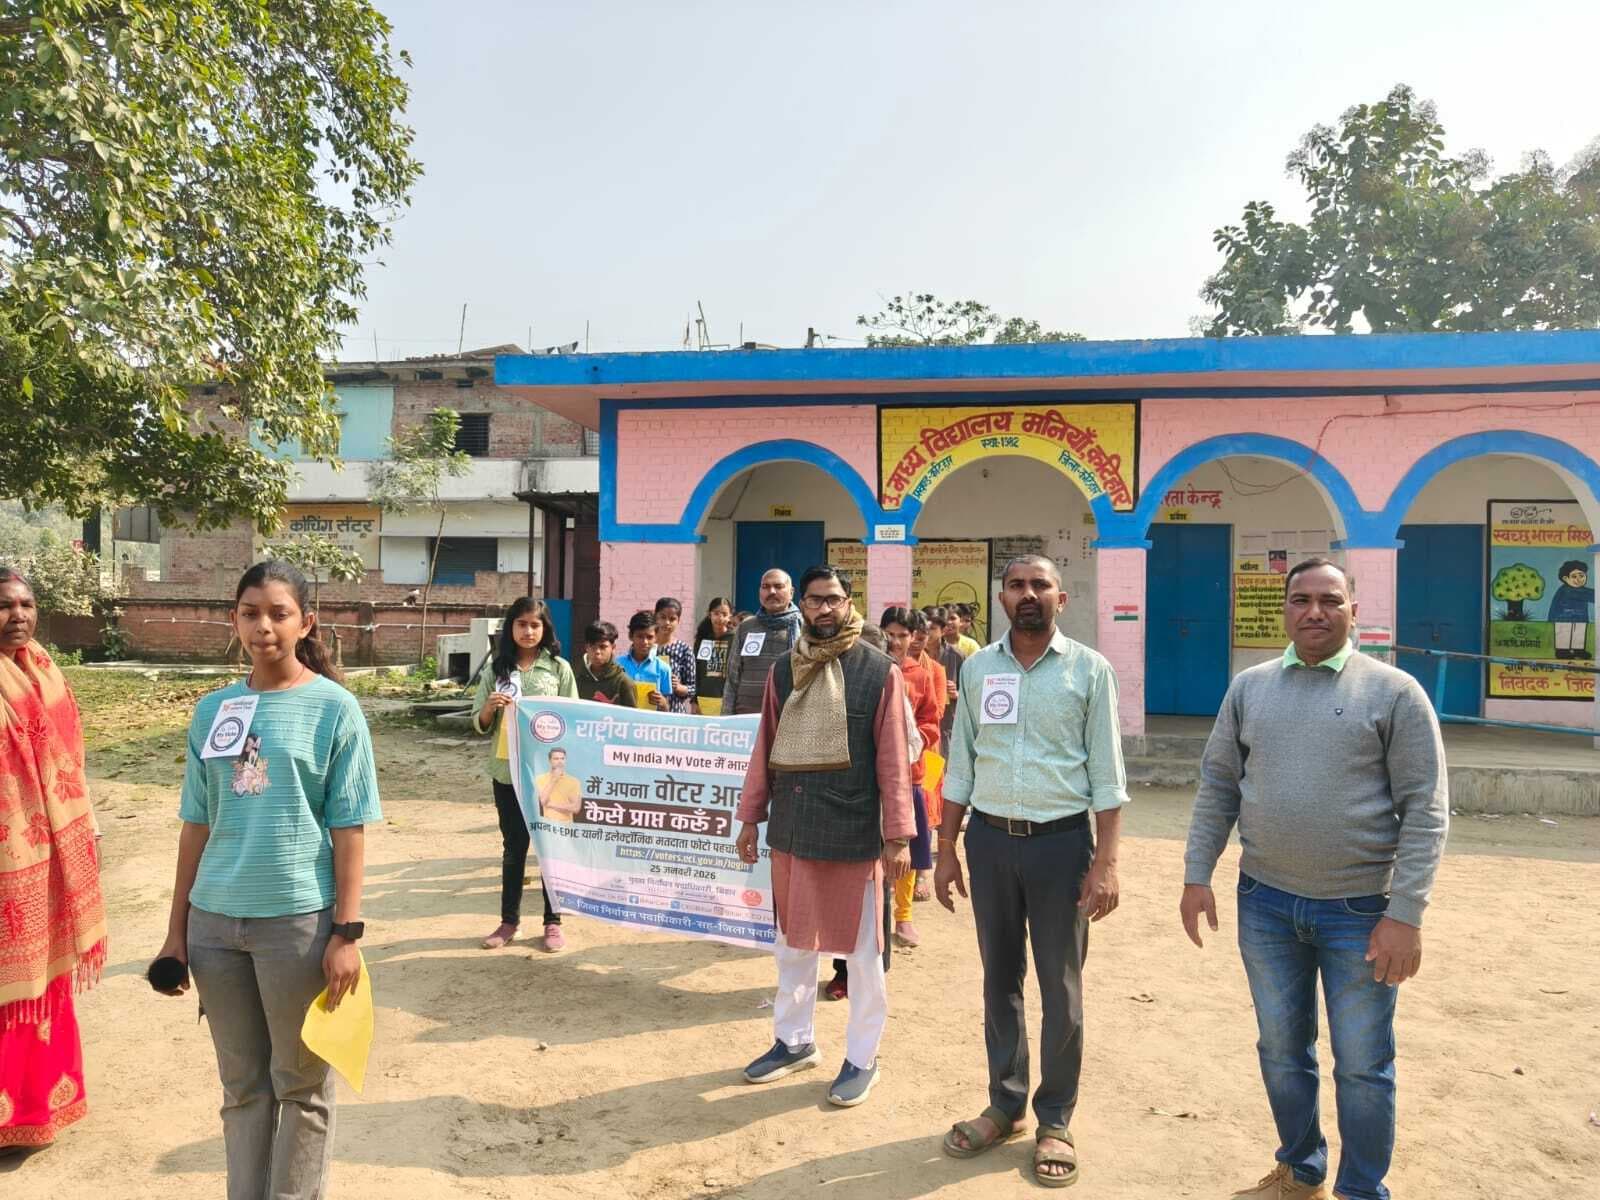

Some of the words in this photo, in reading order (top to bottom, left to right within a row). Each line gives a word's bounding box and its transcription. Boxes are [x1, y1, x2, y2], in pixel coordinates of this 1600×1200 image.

[887, 445, 926, 492] मध्य
[920, 411, 1014, 457] विद्यालय
[1187, 483, 1223, 509] केन्द्र
[336, 516, 375, 532] सेंटर
[1531, 529, 1565, 543] भारत
[576, 717, 629, 742] राष्ट्रीय
[633, 723, 700, 744] मतदाता
[613, 752, 630, 764] My
[633, 752, 662, 764] India
[665, 755, 682, 768] My
[686, 756, 712, 769] Vote
[714, 756, 727, 769] मैं
[586, 776, 604, 795] मैं
[606, 781, 650, 799] अपना
[654, 774, 705, 805] वोटर
[584, 801, 626, 825] कैसे
[629, 806, 666, 830] प्राप्त
[670, 808, 711, 832] करूँ
[715, 817, 728, 834] ?
[582, 828, 603, 840] यानी
[605, 830, 653, 845] इलेक्ट्रॉनिक
[655, 835, 688, 849] मतदाता
[690, 838, 711, 851] फोटो
[620, 847, 750, 872] https://voters.eci.gov.in/login
[650, 864, 661, 873] 25
[663, 866, 691, 877] जनवरी
[693, 870, 716, 880] 2026
[577, 898, 600, 913] जिला
[600, 904, 637, 920] निर्वाचन
